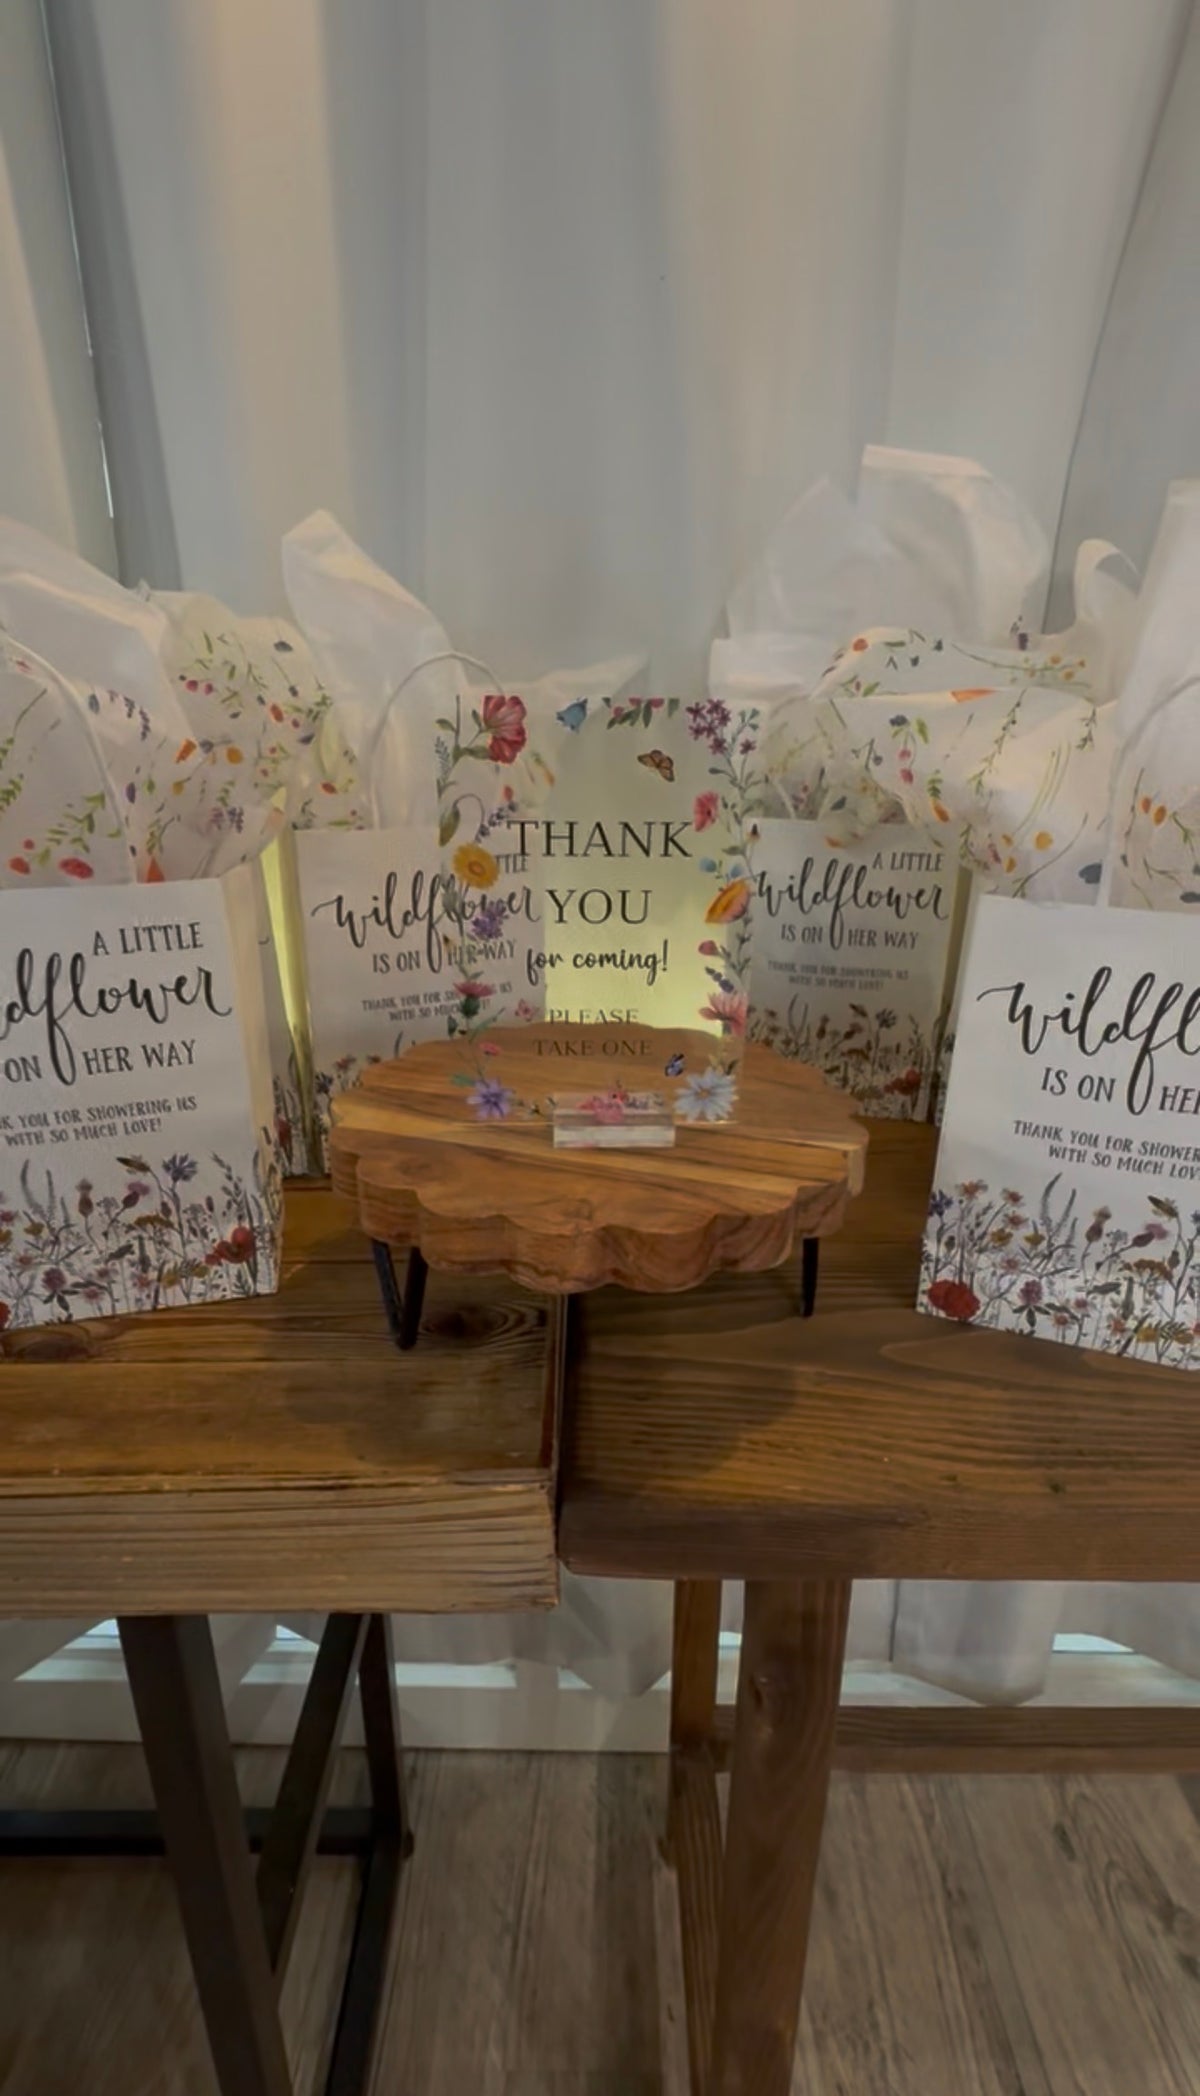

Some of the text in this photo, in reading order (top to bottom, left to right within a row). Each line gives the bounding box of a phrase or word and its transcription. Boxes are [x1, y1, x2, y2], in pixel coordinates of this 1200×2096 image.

[507, 820, 693, 858] THANK
[873, 852, 945, 872] A LITTLE
[546, 888, 653, 925] YOU
[754, 857, 949, 950] wildflower
[92, 922, 204, 956] A LITTLE
[780, 924, 920, 951] IS ON HER WAY
[372, 953, 391, 974] IS
[396, 950, 421, 973] ON
[481, 938, 517, 961] WAY
[526, 939, 668, 987] for coming!
[0, 948, 233, 1086] dflower
[549, 1008, 640, 1025] PLEASE
[3, 1039, 197, 1083] ON HER WAY
[532, 1040, 654, 1057] TAKE ONE
[1041, 1067, 1068, 1096] IS
[1077, 1075, 1116, 1103] ON
[18, 1111, 50, 1129] YOU
[54, 1106, 83, 1125] FOR
[87, 1098, 172, 1122] SHOWERING
[175, 1096, 198, 1111] US
[4, 1117, 162, 1147] WITH SO MUCH LOVE!
[1013, 1119, 1063, 1142] THANK
[1069, 1130, 1100, 1149] YOU
[1104, 1135, 1134, 1154] FOR
[1048, 1145, 1200, 1181] WITH SO MUCH LOV
